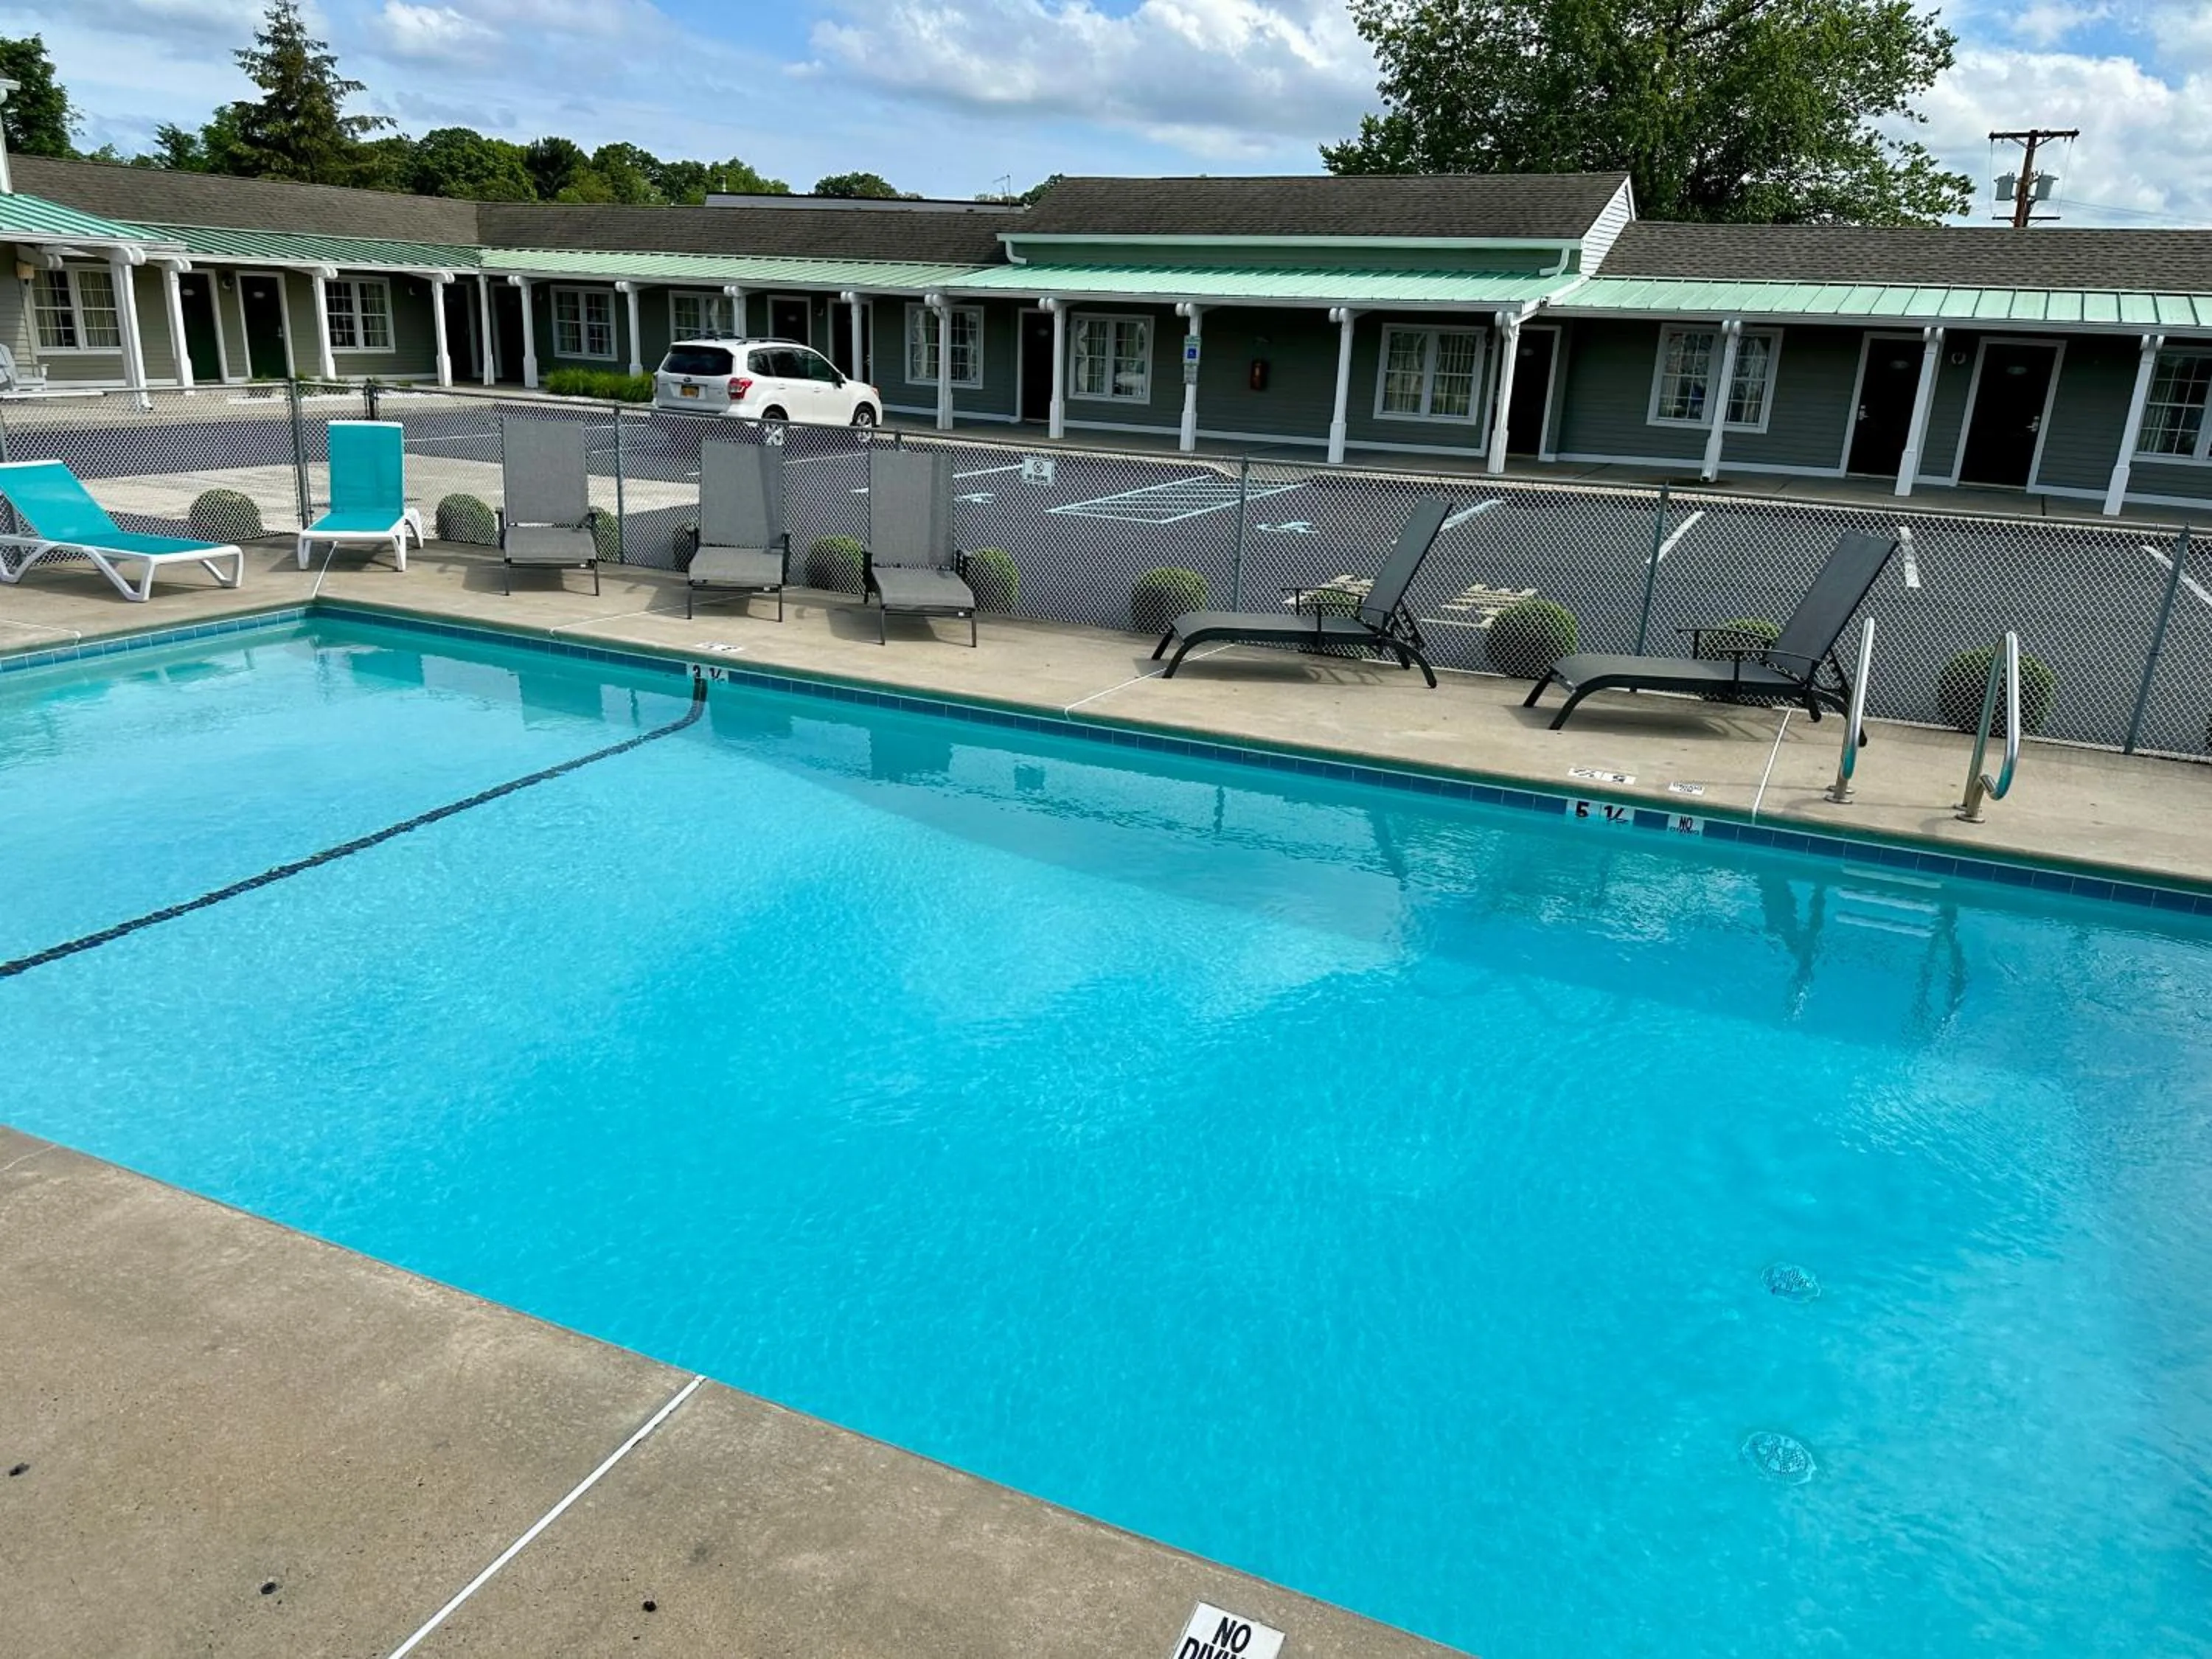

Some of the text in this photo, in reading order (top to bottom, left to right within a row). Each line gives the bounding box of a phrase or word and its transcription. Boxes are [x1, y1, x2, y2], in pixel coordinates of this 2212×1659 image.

[1576, 801, 1590, 818] 5
[1680, 815, 1694, 830] NO
[1211, 1616, 1251, 1653] NO
